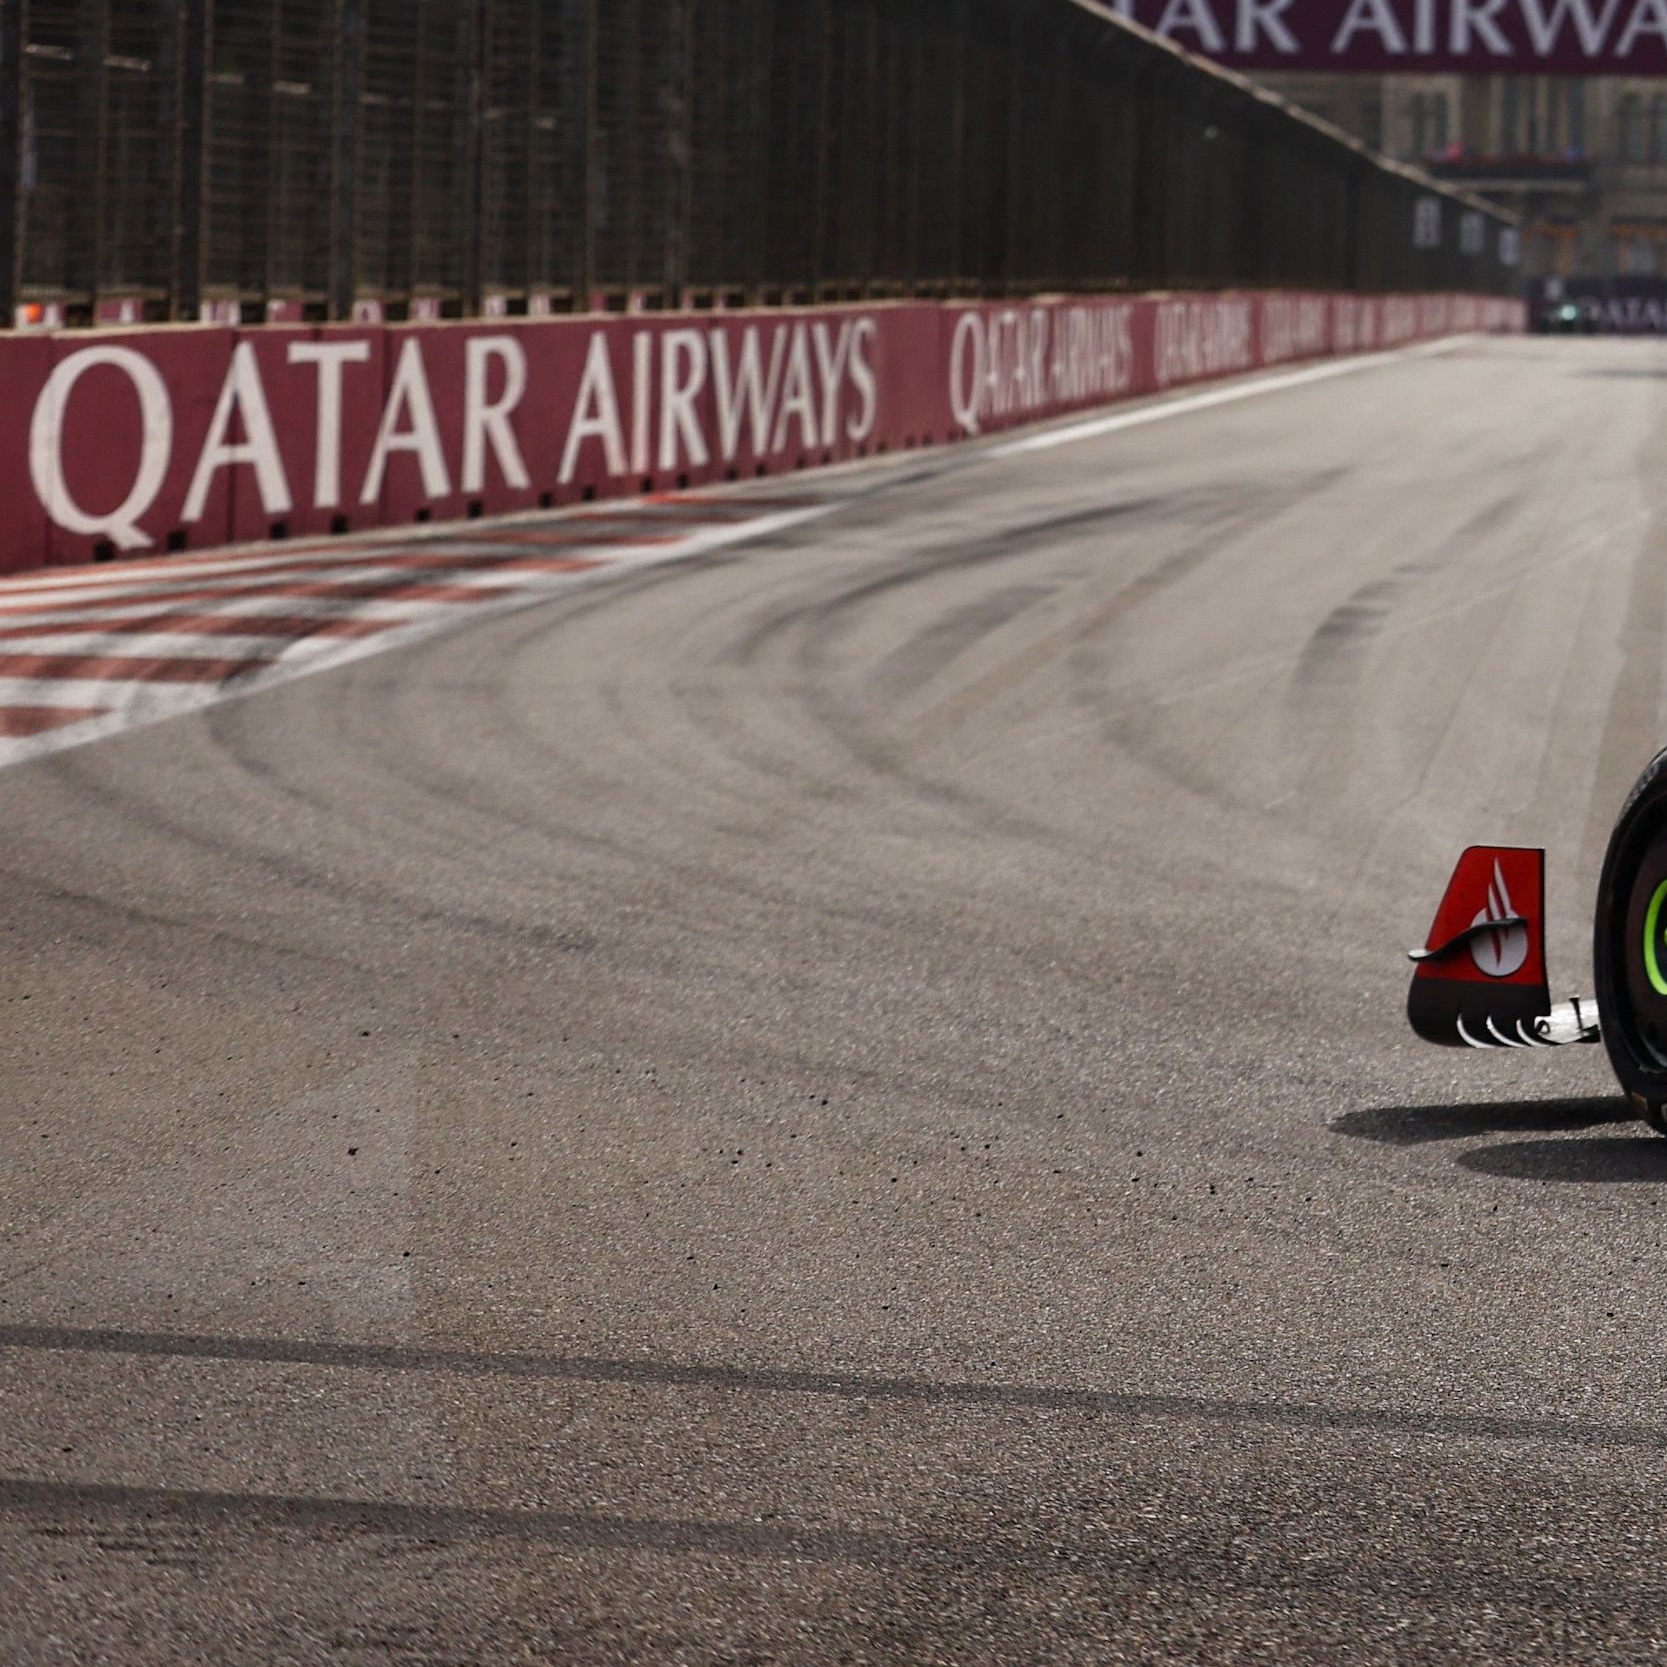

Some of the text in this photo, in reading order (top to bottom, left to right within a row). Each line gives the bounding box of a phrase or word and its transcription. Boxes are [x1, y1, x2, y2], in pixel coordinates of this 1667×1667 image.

[28, 317, 879, 550] QATAR AIRWAYS
[950, 306, 1050, 434] QATAR
